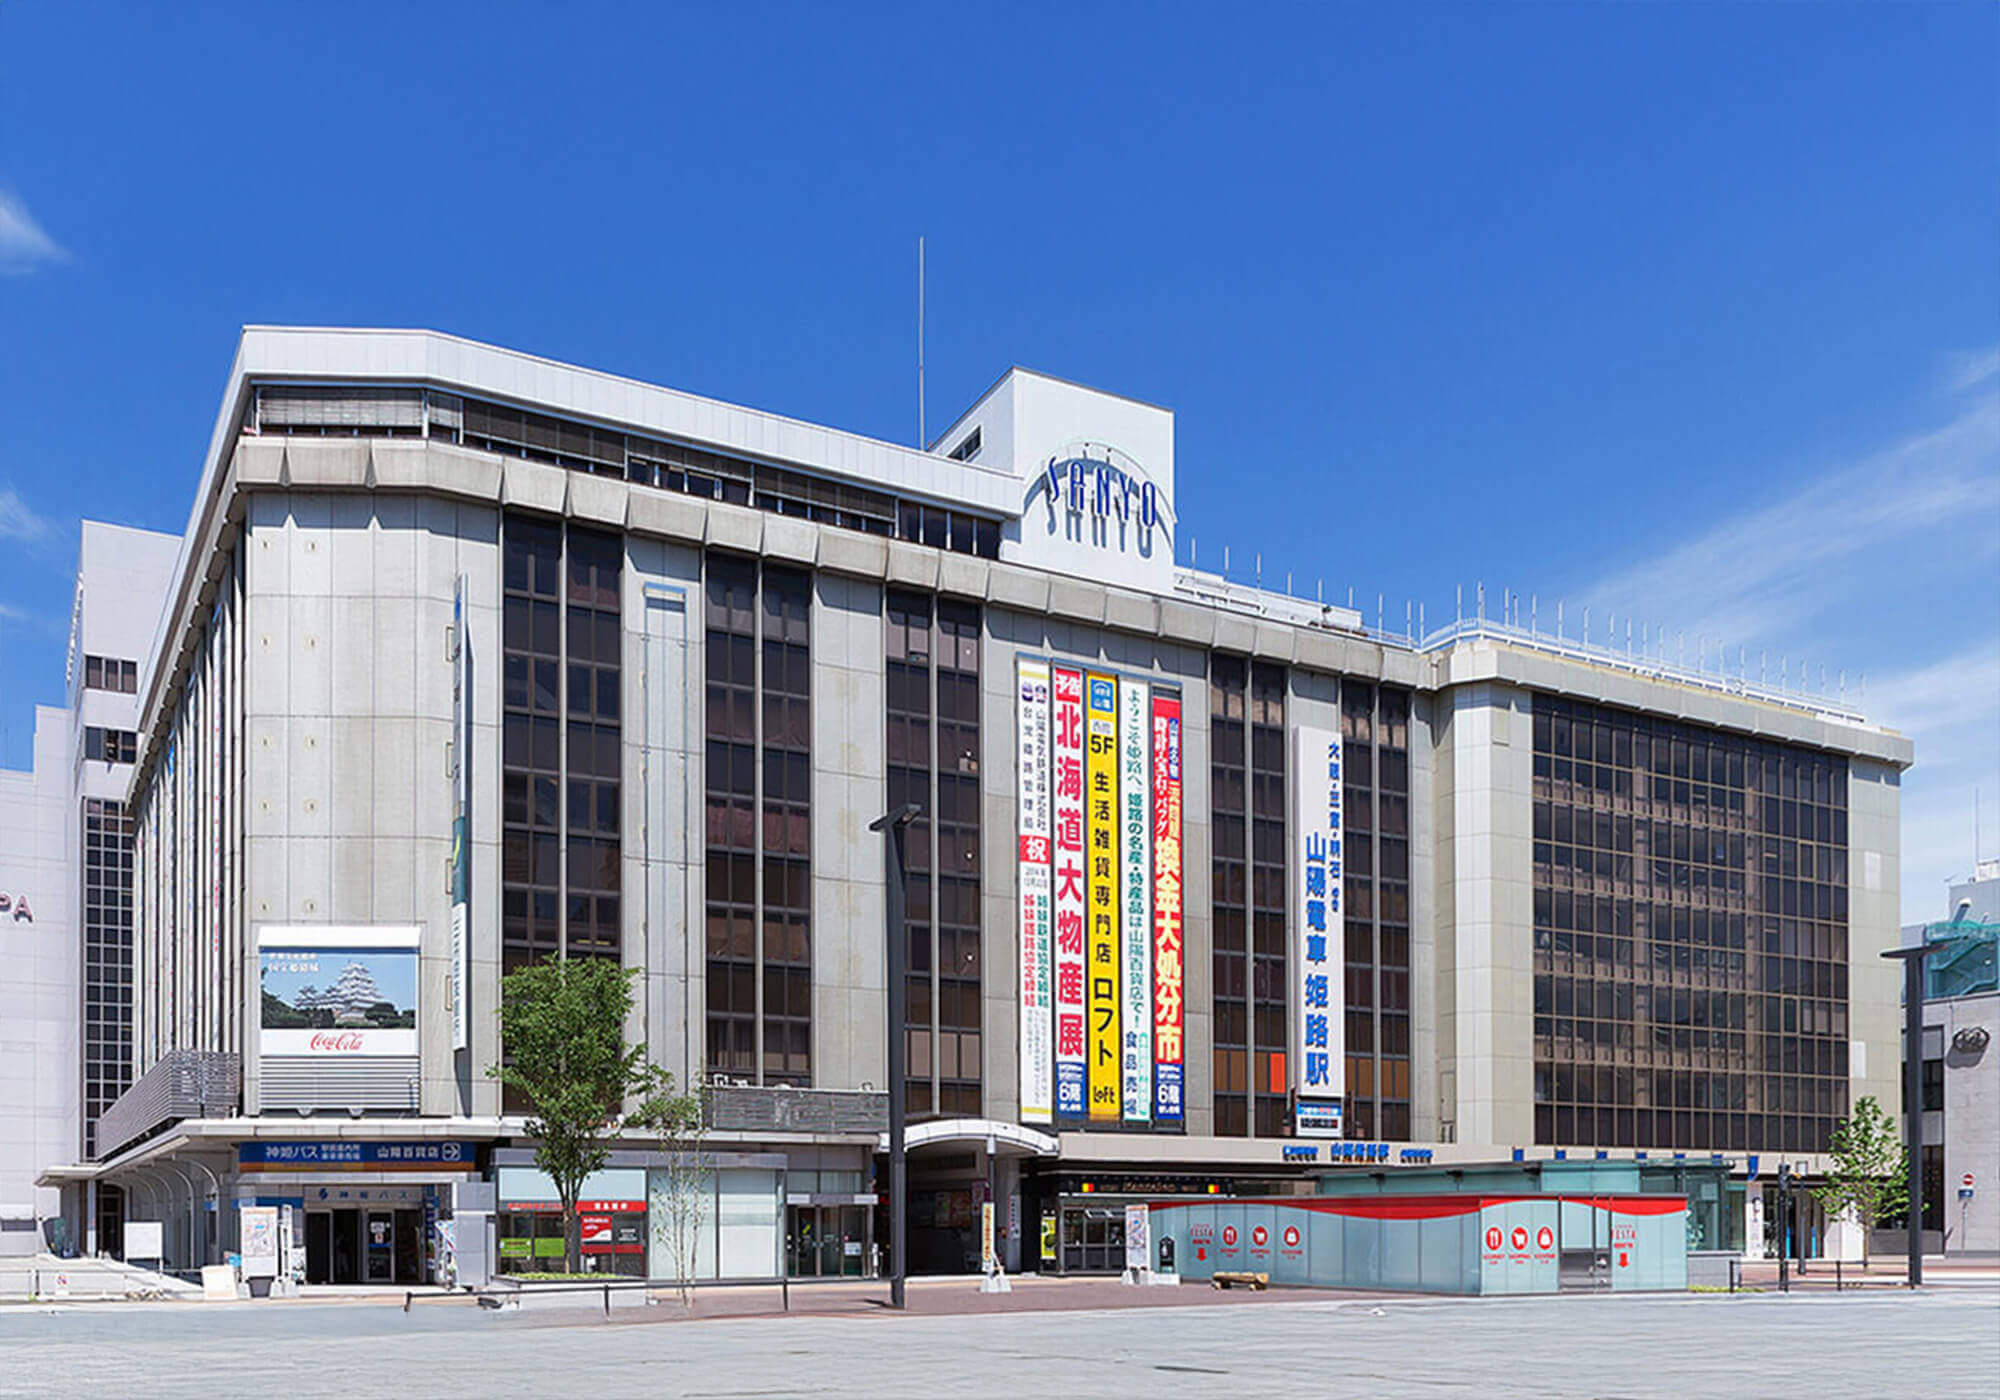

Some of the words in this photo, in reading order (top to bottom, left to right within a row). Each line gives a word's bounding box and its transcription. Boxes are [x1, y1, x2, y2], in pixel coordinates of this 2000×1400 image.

[1047, 456, 1156, 528] SANYO
[1090, 735, 1114, 755] 5F
[1026, 836, 1047, 861] 祝
[1056, 703, 1084, 1057] 北海道大物産展
[1095, 771, 1111, 964] 生活雑貨専門店
[1305, 832, 1328, 964] 山陽電車
[1094, 978, 1113, 1067] ロフト
[1304, 973, 1330, 1086] 姫路駅
[265, 1146, 318, 1159] 神姫バス
[376, 1147, 439, 1159] 山陽百貨店
